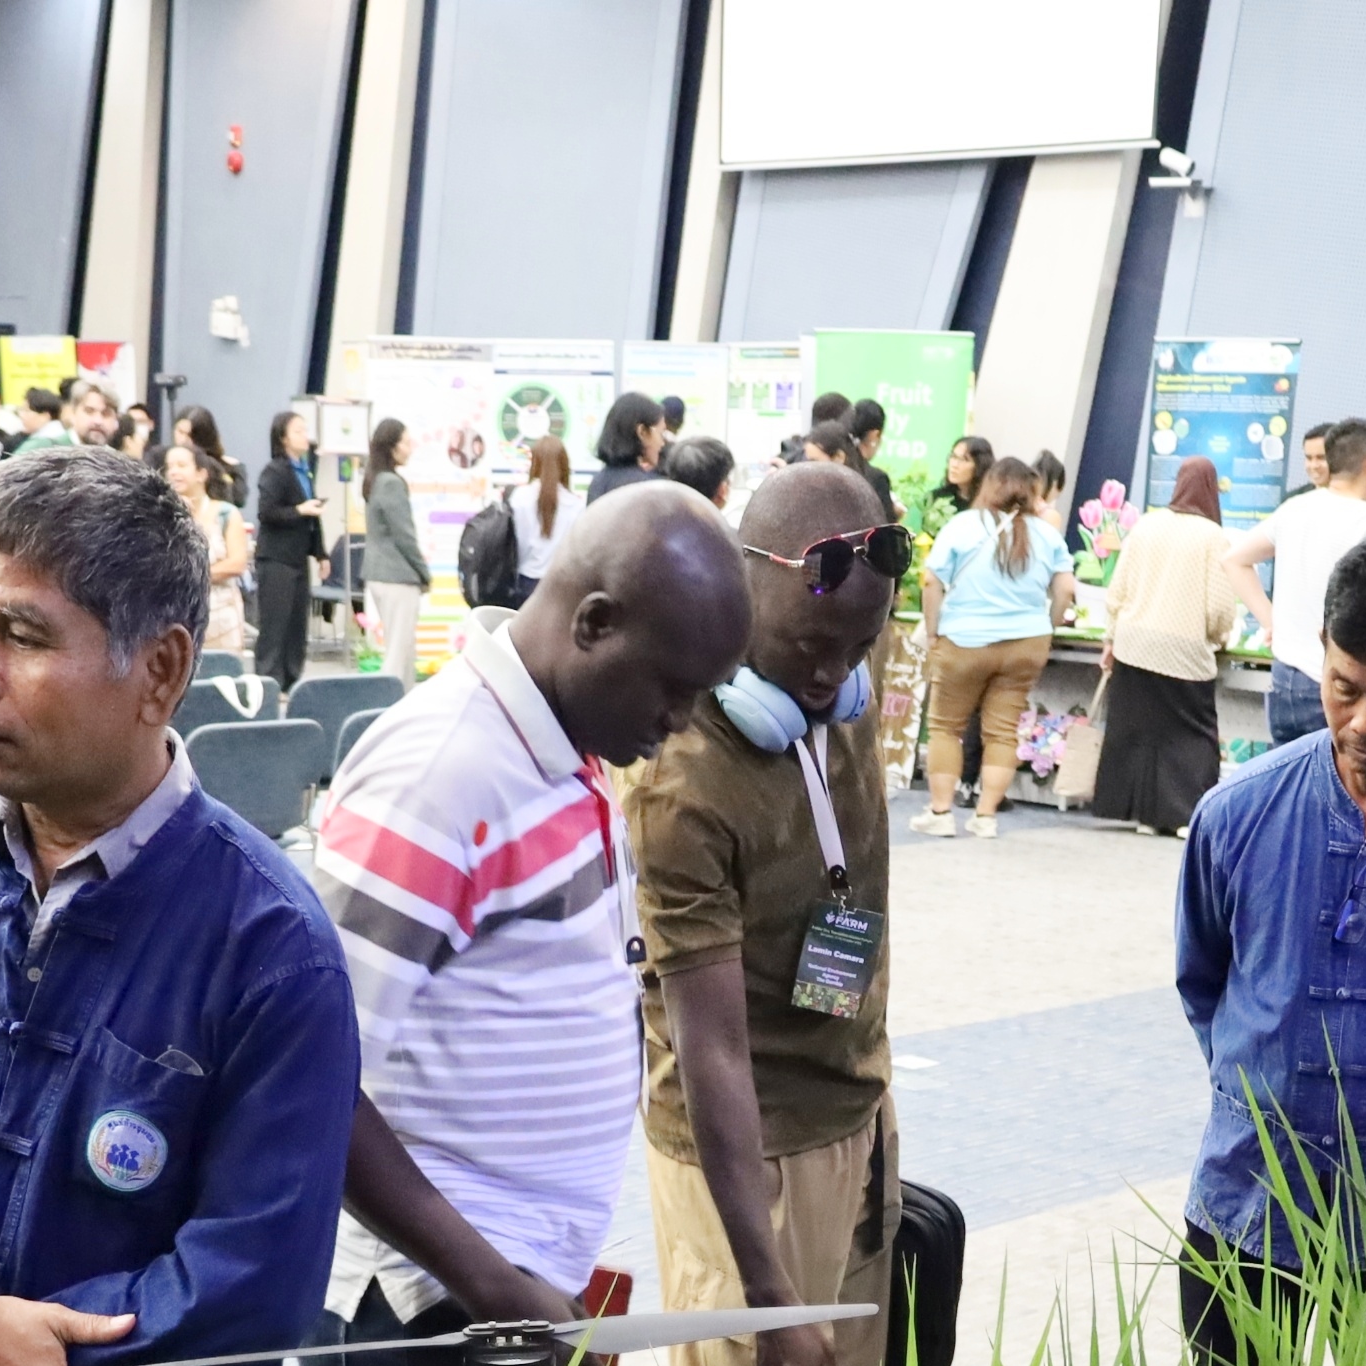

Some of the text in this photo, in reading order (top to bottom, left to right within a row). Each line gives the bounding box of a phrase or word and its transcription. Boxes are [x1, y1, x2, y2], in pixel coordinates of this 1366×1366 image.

[876, 381, 933, 406] Fruit
[835, 916, 868, 931] FARM
[808, 945, 864, 964] Lamin Camara
